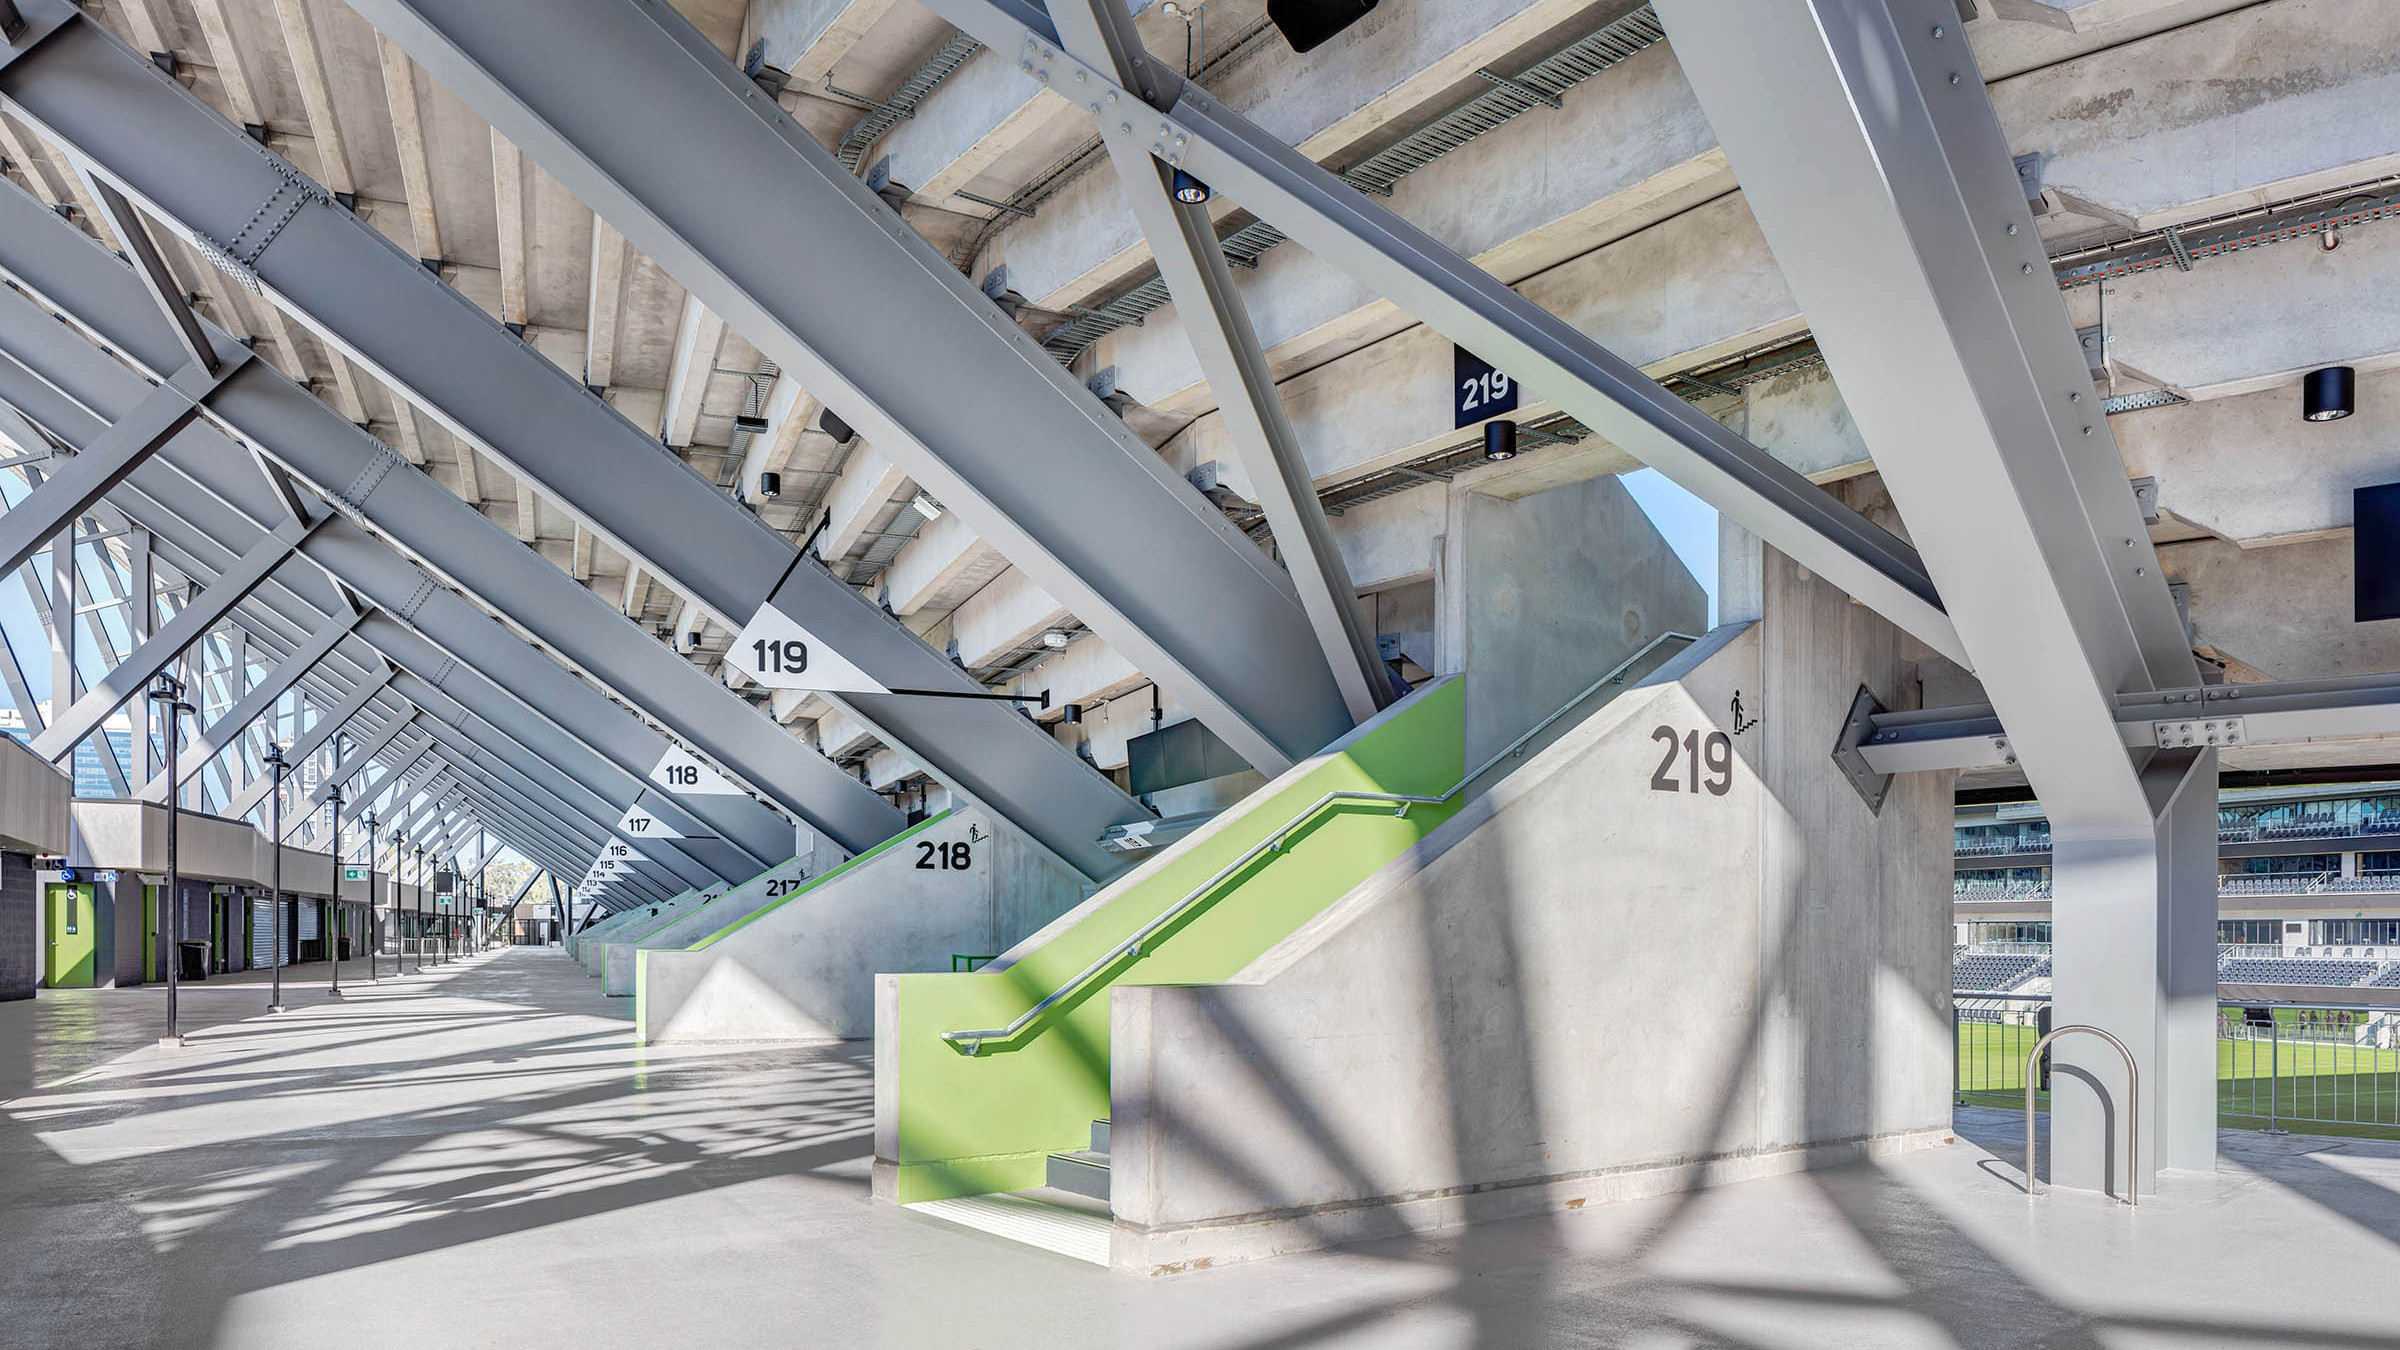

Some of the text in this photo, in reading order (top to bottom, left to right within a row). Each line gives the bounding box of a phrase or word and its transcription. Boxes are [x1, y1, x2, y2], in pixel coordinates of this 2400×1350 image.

[1463, 370, 1508, 411] 219
[753, 639, 807, 674] 119
[1651, 725, 1732, 796] 219
[666, 765, 698, 785] 118
[629, 818, 651, 832] 117
[610, 845, 627, 856] 116
[915, 841, 971, 870] 218
[600, 860, 615, 869] 115
[592, 870, 605, 878] 114
[766, 879, 800, 896] 217
